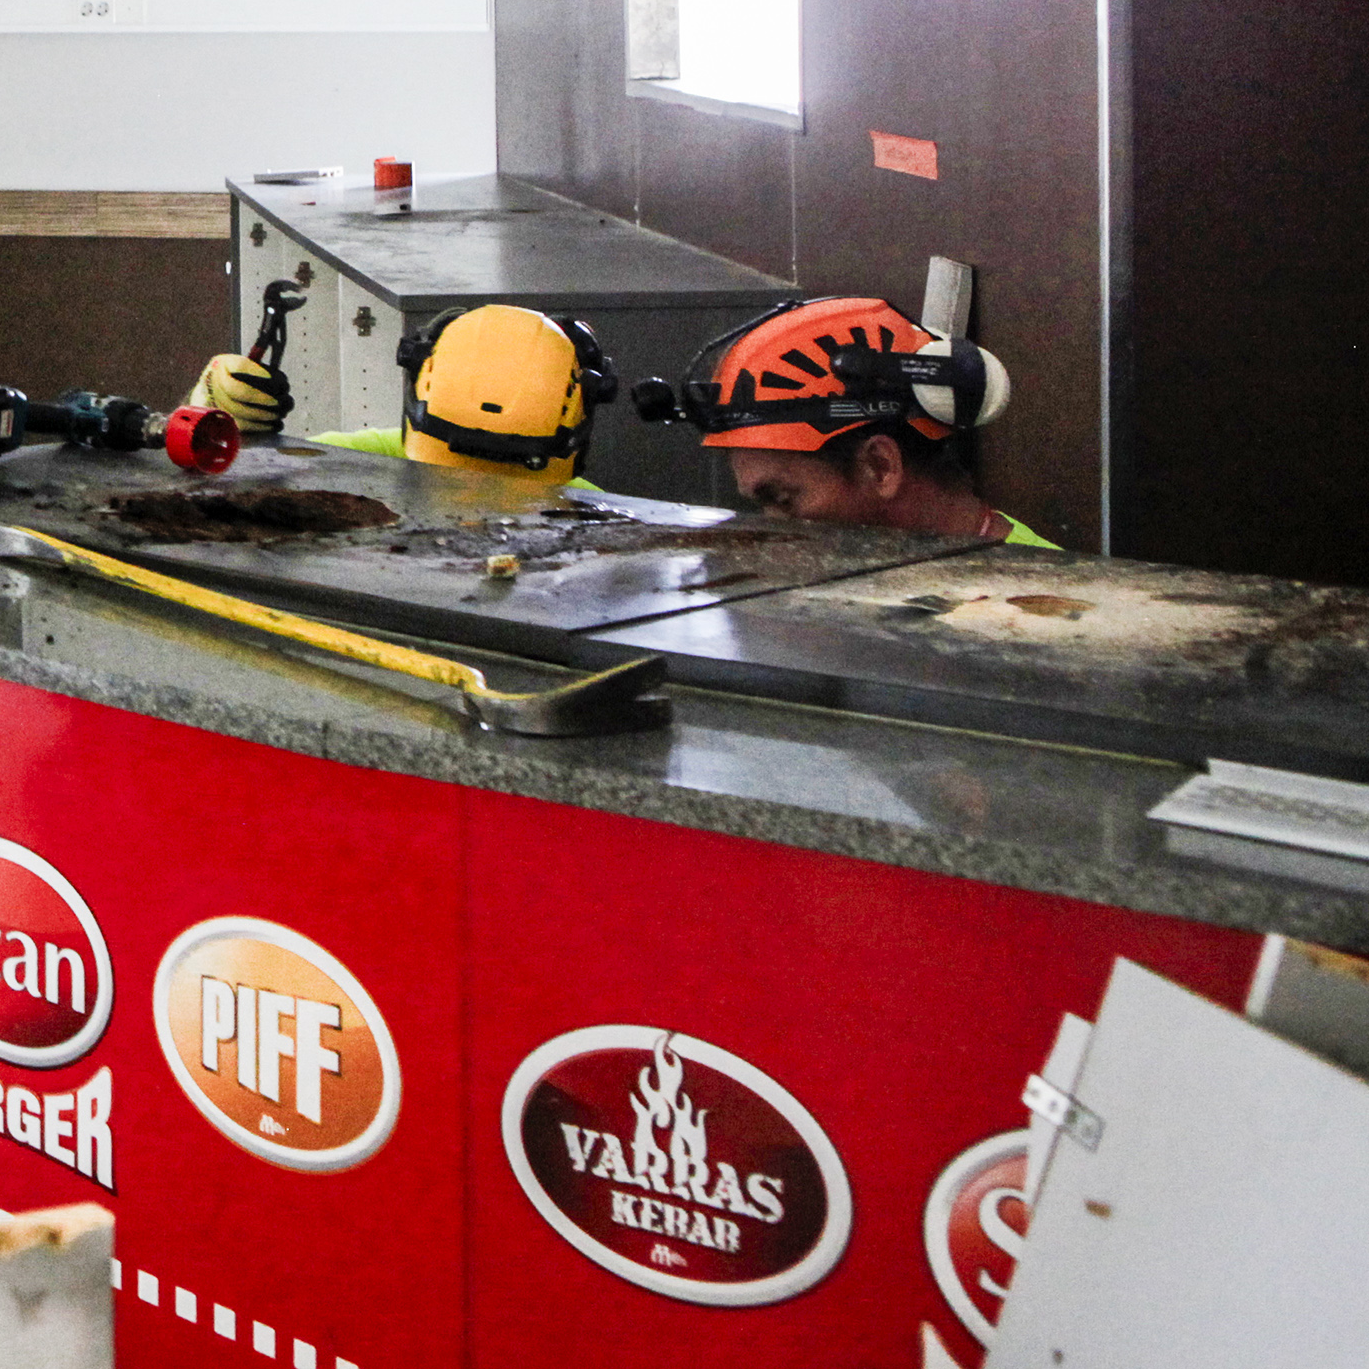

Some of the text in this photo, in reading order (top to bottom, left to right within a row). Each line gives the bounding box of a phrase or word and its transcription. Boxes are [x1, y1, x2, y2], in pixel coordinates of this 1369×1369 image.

[868, 401, 901, 413] LED
[201, 975, 343, 1126] PIFF
[560, 1112, 785, 1226] VARRAS
[611, 1190, 741, 1255] KEBAB
